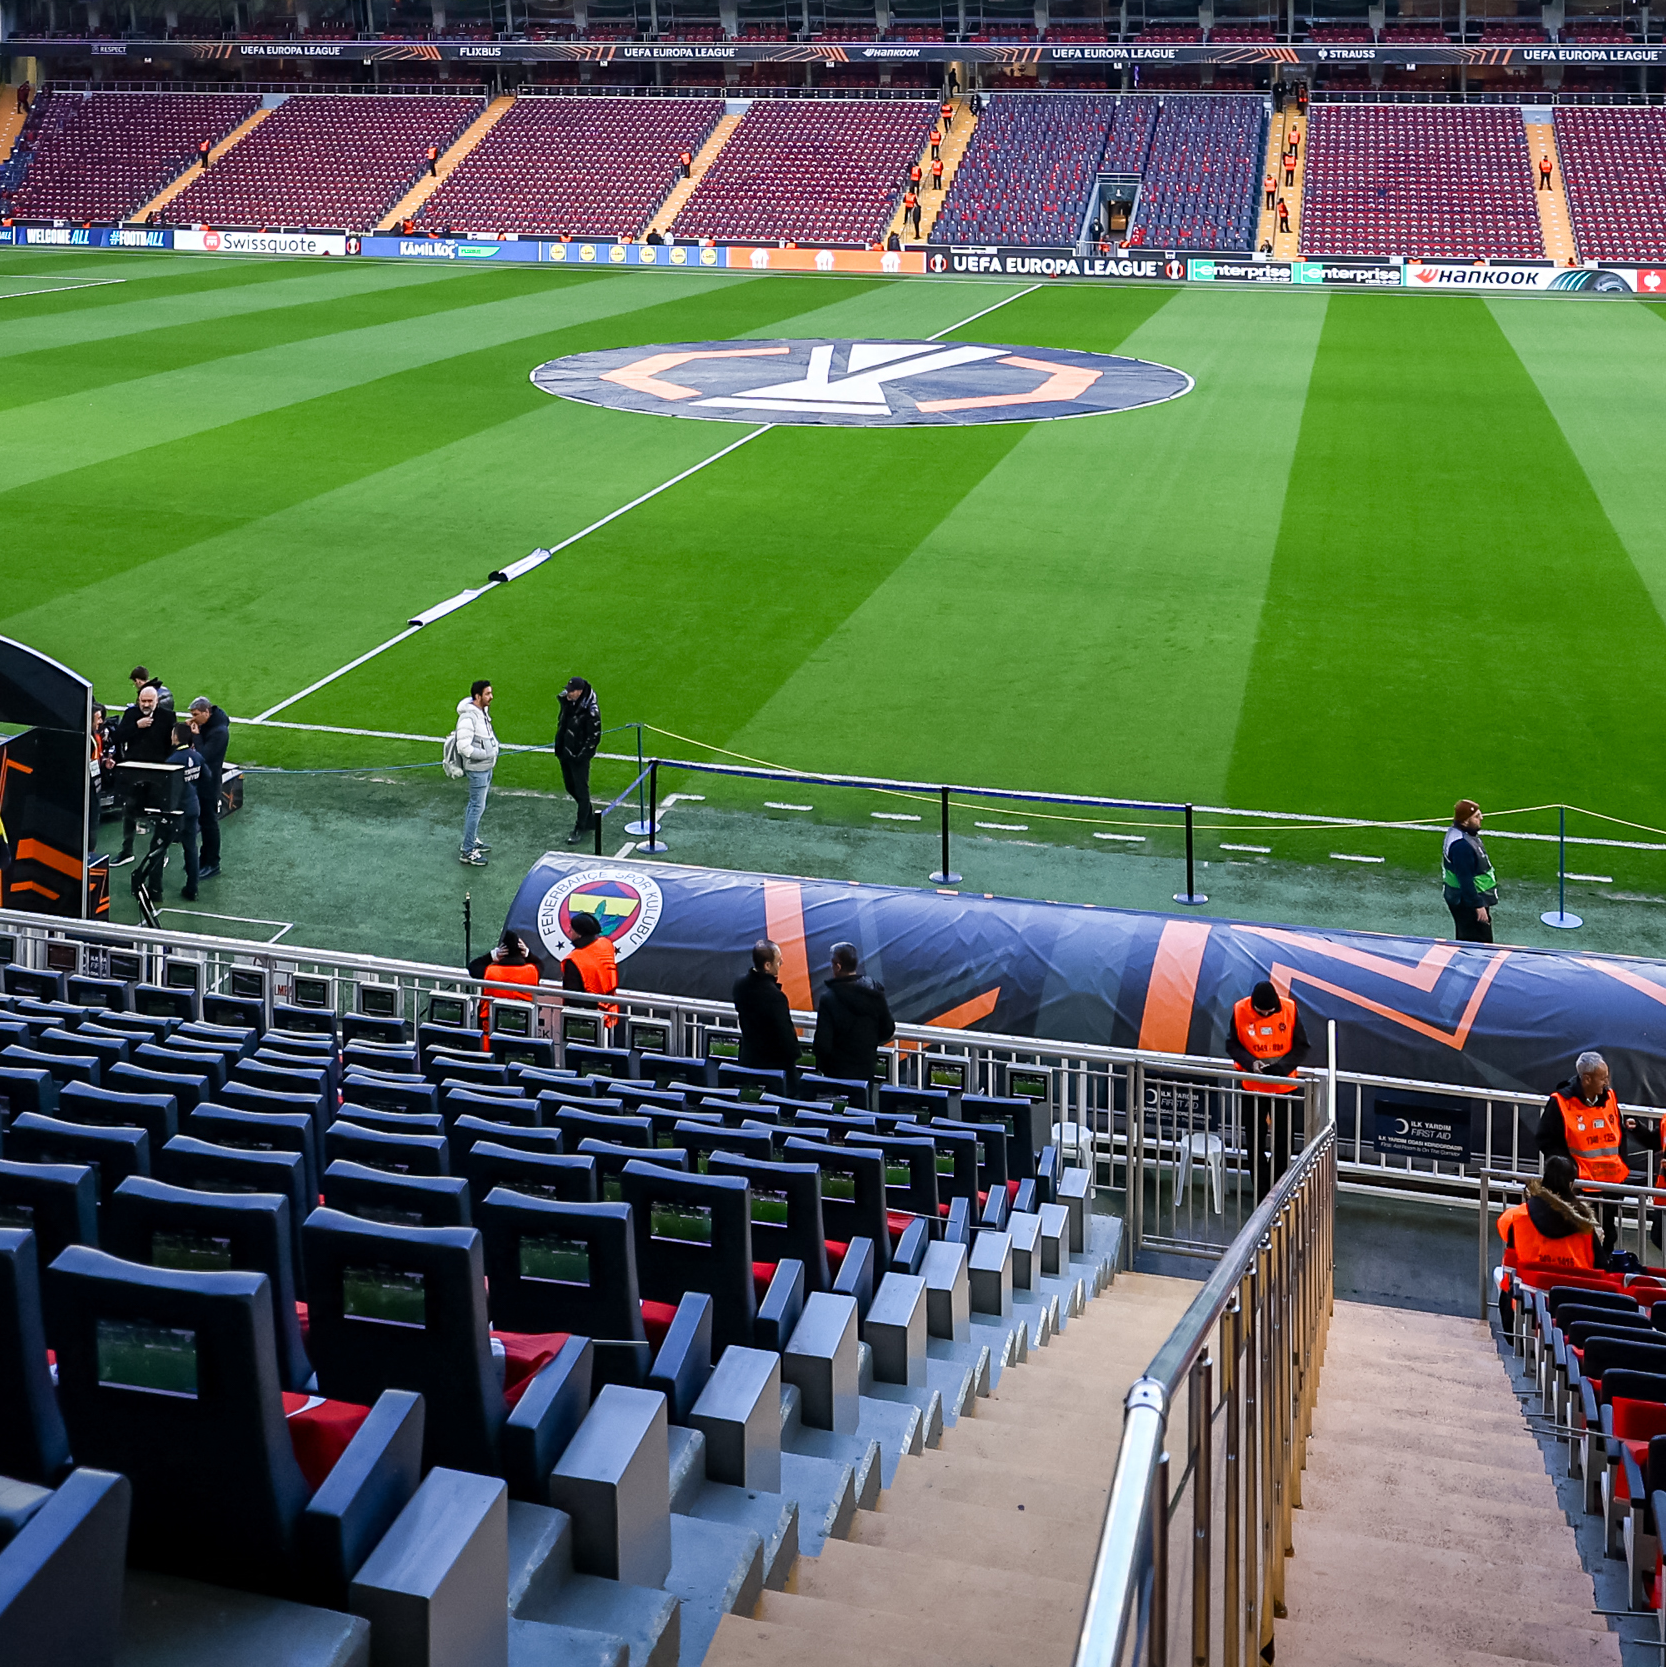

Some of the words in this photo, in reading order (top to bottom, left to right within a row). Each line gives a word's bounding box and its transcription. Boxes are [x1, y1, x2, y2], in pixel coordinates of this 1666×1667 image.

[240, 46, 264, 56] UEFA
[266, 46, 302, 56] EUROPA
[460, 47, 502, 57] FLIXBUS
[624, 48, 651, 58] UEFA
[653, 48, 694, 58] EUROPA
[1052, 49, 1082, 59] UEFA
[1084, 49, 1129, 59] EUROPA
[1131, 49, 1176, 60] LEAGUE
[1329, 49, 1376, 59] STRAUSS
[1523, 50, 1554, 60] UEFA
[1557, 50, 1608, 60] EUROPA
[1610, 50, 1659, 61] LEAGUE
[27, 228, 71, 245] WELCOME
[71, 228, 90, 245] ALL
[109, 229, 165, 247] #FOOTBALL
[223, 231, 317, 255] Swissquote
[953, 255, 1003, 273] UEFA
[1006, 257, 1080, 275] EUROPA
[1084, 259, 1158, 277] LEAGUE
[1200, 263, 1291, 281] enterprise
[1309, 266, 1401, 283] enterprise
[1411, 1128, 1434, 1138] FIRST
[1435, 1131, 1451, 1140] AID
